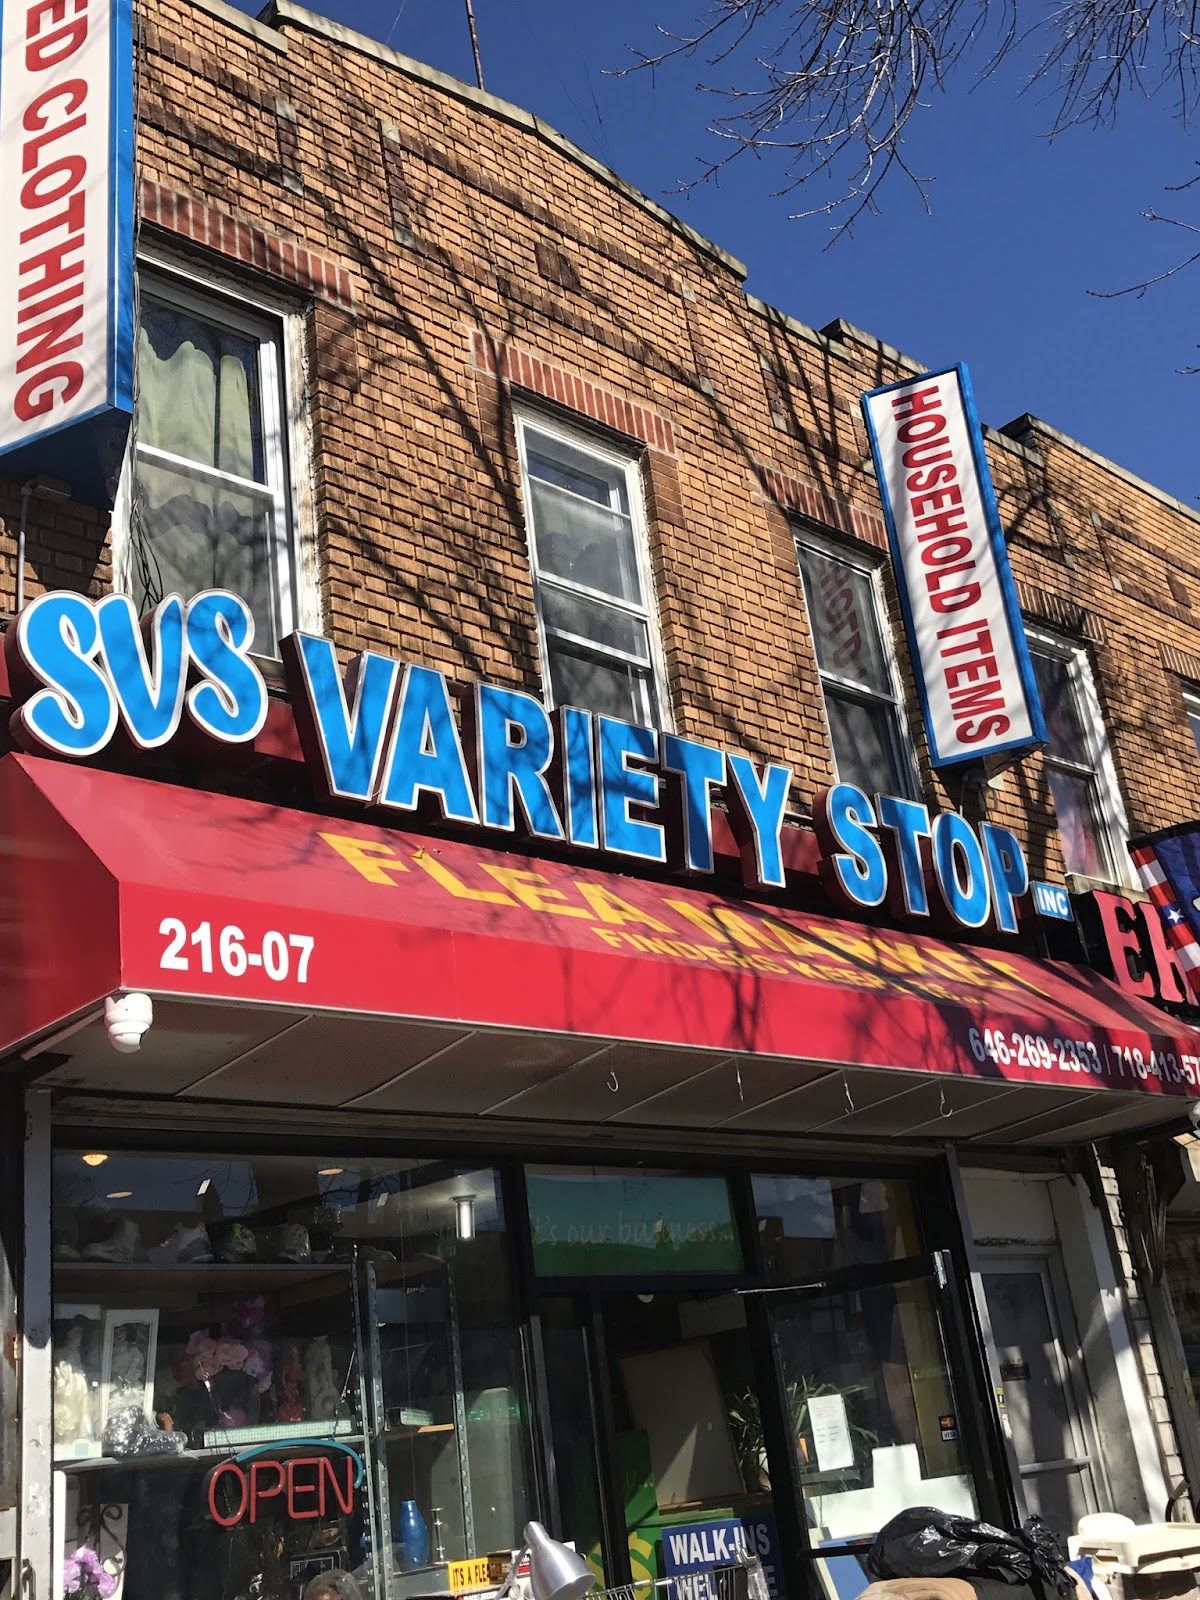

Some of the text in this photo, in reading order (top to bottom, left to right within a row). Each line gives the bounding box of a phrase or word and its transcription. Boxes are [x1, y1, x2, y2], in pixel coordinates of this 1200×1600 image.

[13, 78, 89, 422] CLOTHING
[891, 385, 1011, 744] HOUSEHOLD ITEMS
[17, 588, 269, 757] SVS
[294, 629, 1070, 934] VARIETY STOP INC
[316, 831, 1053, 999] FLEA MARKET
[158, 917, 315, 984] 216-07
[589, 927, 789, 975] FINDERS
[968, 1027, 1103, 1075] 646-269-2353
[1111, 1045, 1200, 1086] 718-413-57
[566, 1222, 609, 1245] our
[943, 1430, 957, 1439] VISA
[208, 1456, 354, 1527] OPEN
[467, 1565, 474, 1584] A
[668, 1523, 772, 1566] WALK-INS
